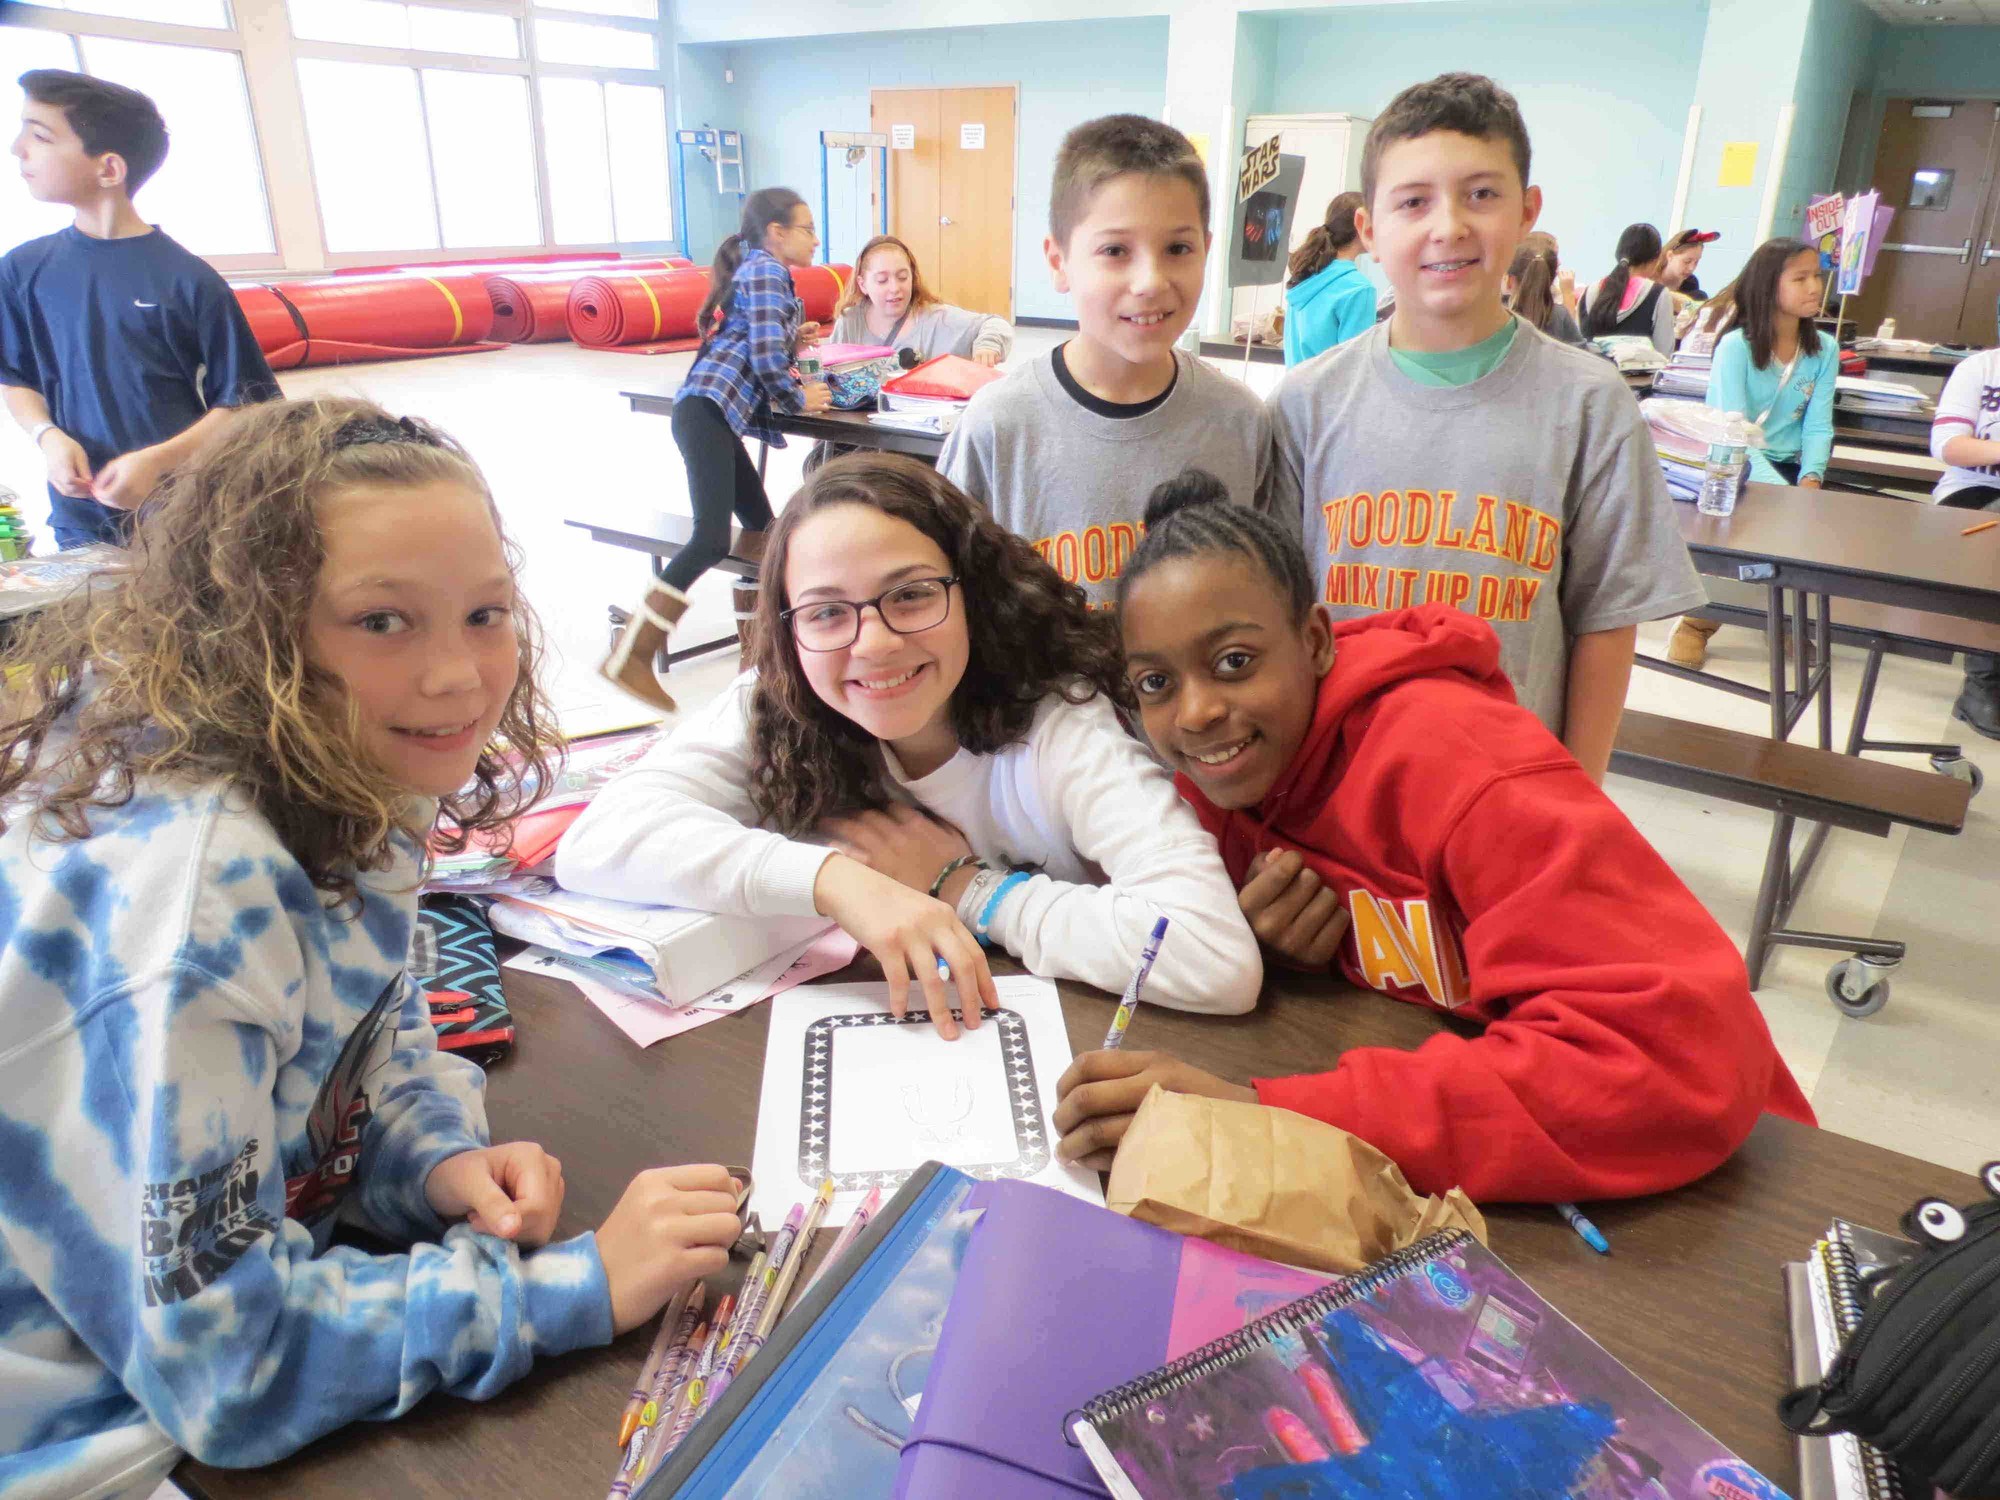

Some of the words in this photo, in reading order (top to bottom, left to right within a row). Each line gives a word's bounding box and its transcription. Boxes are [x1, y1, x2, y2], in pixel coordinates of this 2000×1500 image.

[1242, 135, 1279, 175] STAR
[1241, 155, 1279, 198] WARS
[1807, 197, 1844, 222] INSIDE
[1816, 211, 1840, 232] OUT
[1323, 489, 1561, 573] WOODLAND
[1325, 562, 1380, 609] MIX
[1384, 567, 1420, 611] IT
[1425, 570, 1471, 610] UP
[1477, 575, 1541, 621] DAY
